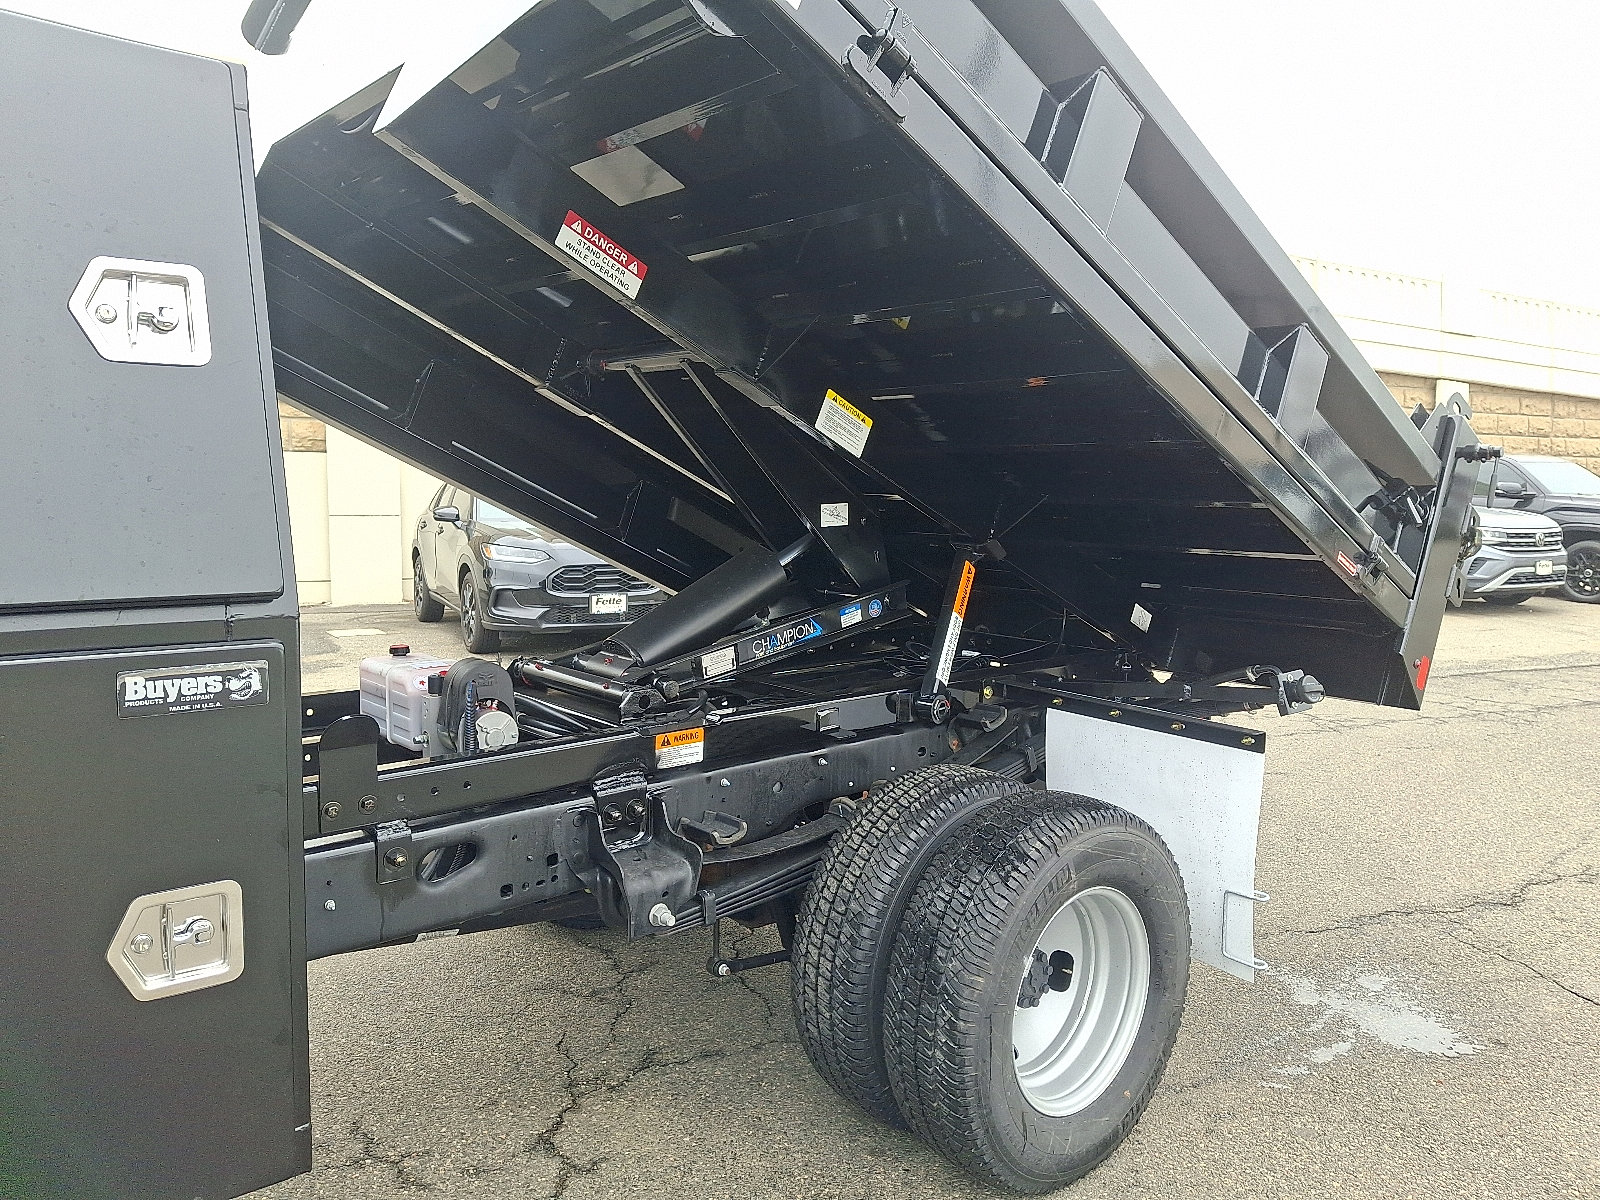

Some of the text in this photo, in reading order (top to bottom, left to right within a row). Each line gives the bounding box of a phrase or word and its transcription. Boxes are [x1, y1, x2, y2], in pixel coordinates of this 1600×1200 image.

[576, 239, 626, 278] STAND CLEAR
[584, 227, 628, 265] DANGER
[565, 241, 630, 291] WHILE OPERATING
[838, 400, 861, 419] CAUTION
[957, 576, 971, 615] WARNING
[753, 622, 814, 653] CHAMPION
[124, 675, 223, 702] Buyers
[180, 693, 215, 702] COMPANY
[125, 698, 164, 708] PRODUCTS
[169, 704, 191, 712] MADE
[674, 732, 699, 742] WARNING
